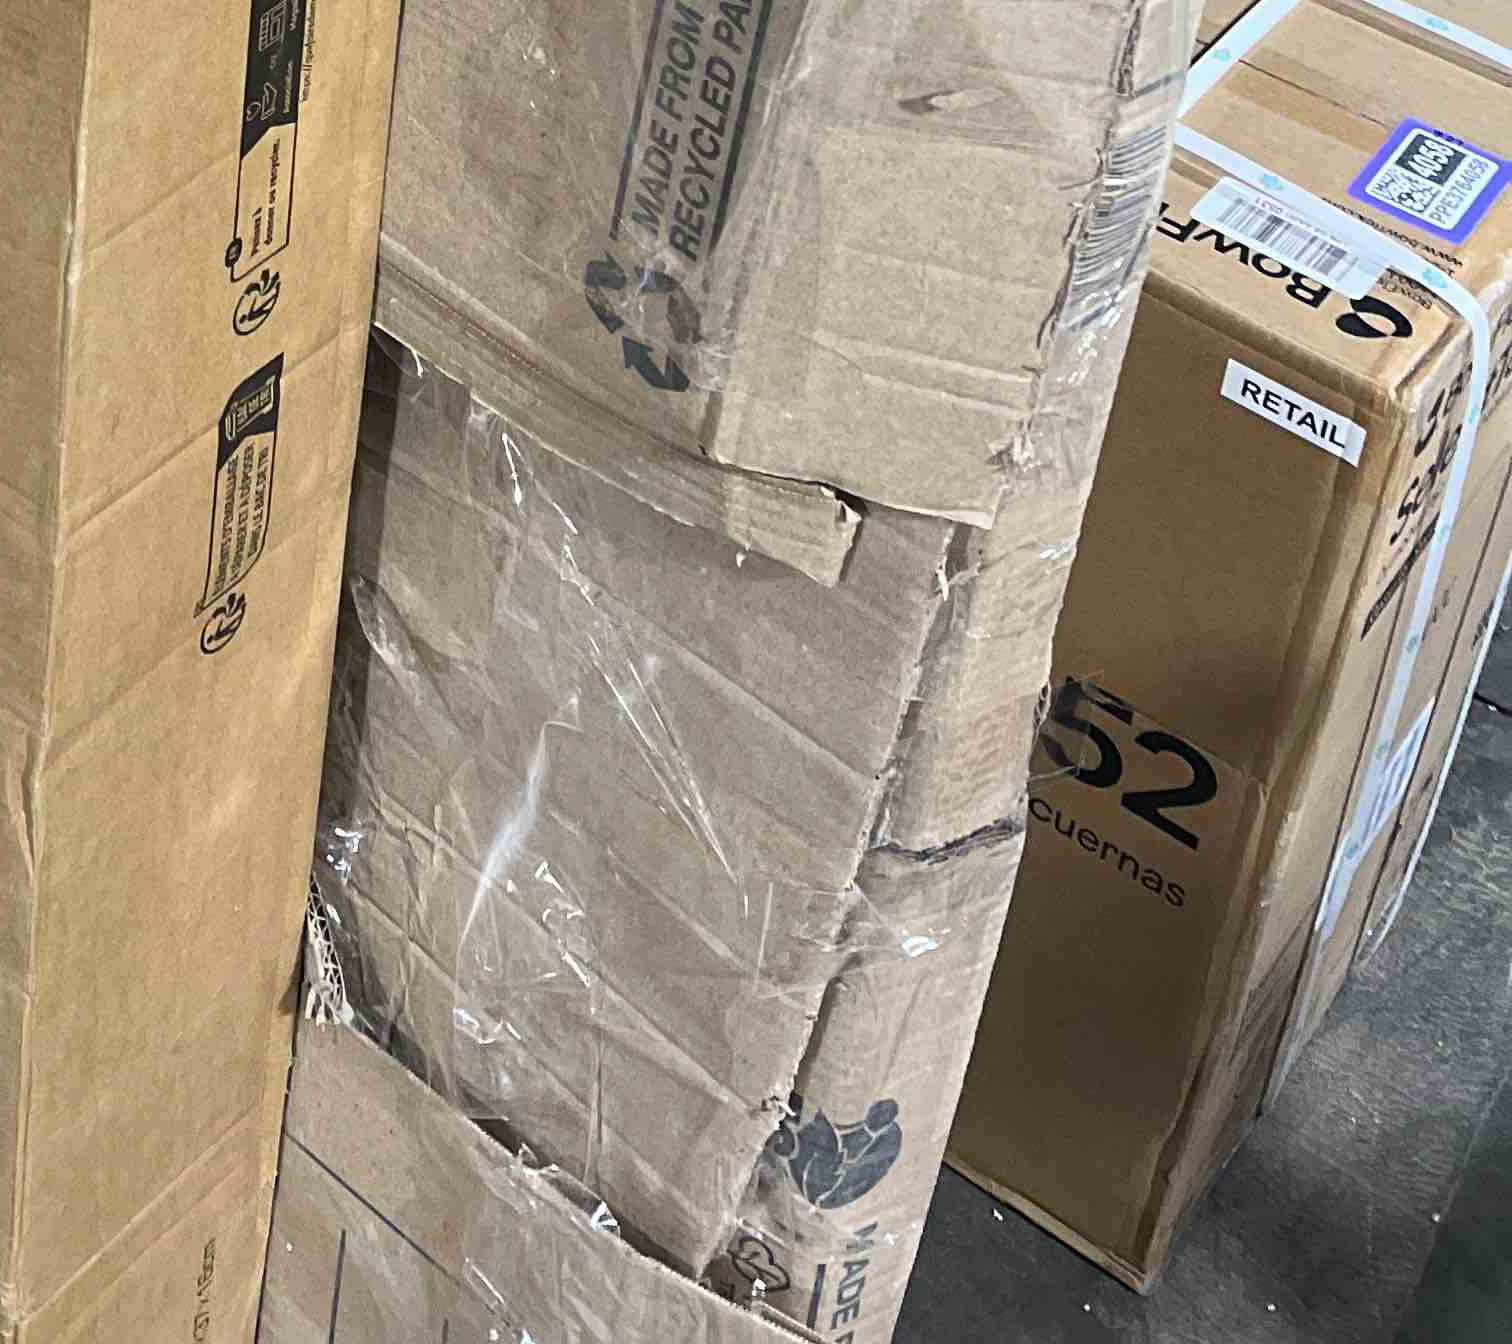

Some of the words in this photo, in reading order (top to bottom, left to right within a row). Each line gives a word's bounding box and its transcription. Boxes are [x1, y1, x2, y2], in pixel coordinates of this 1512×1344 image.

[630, 118, 679, 239] MADE
[655, 5, 705, 124] FROM
[669, 55, 739, 263] RECYCLED
[1238, 377, 1347, 450] RETAIL
